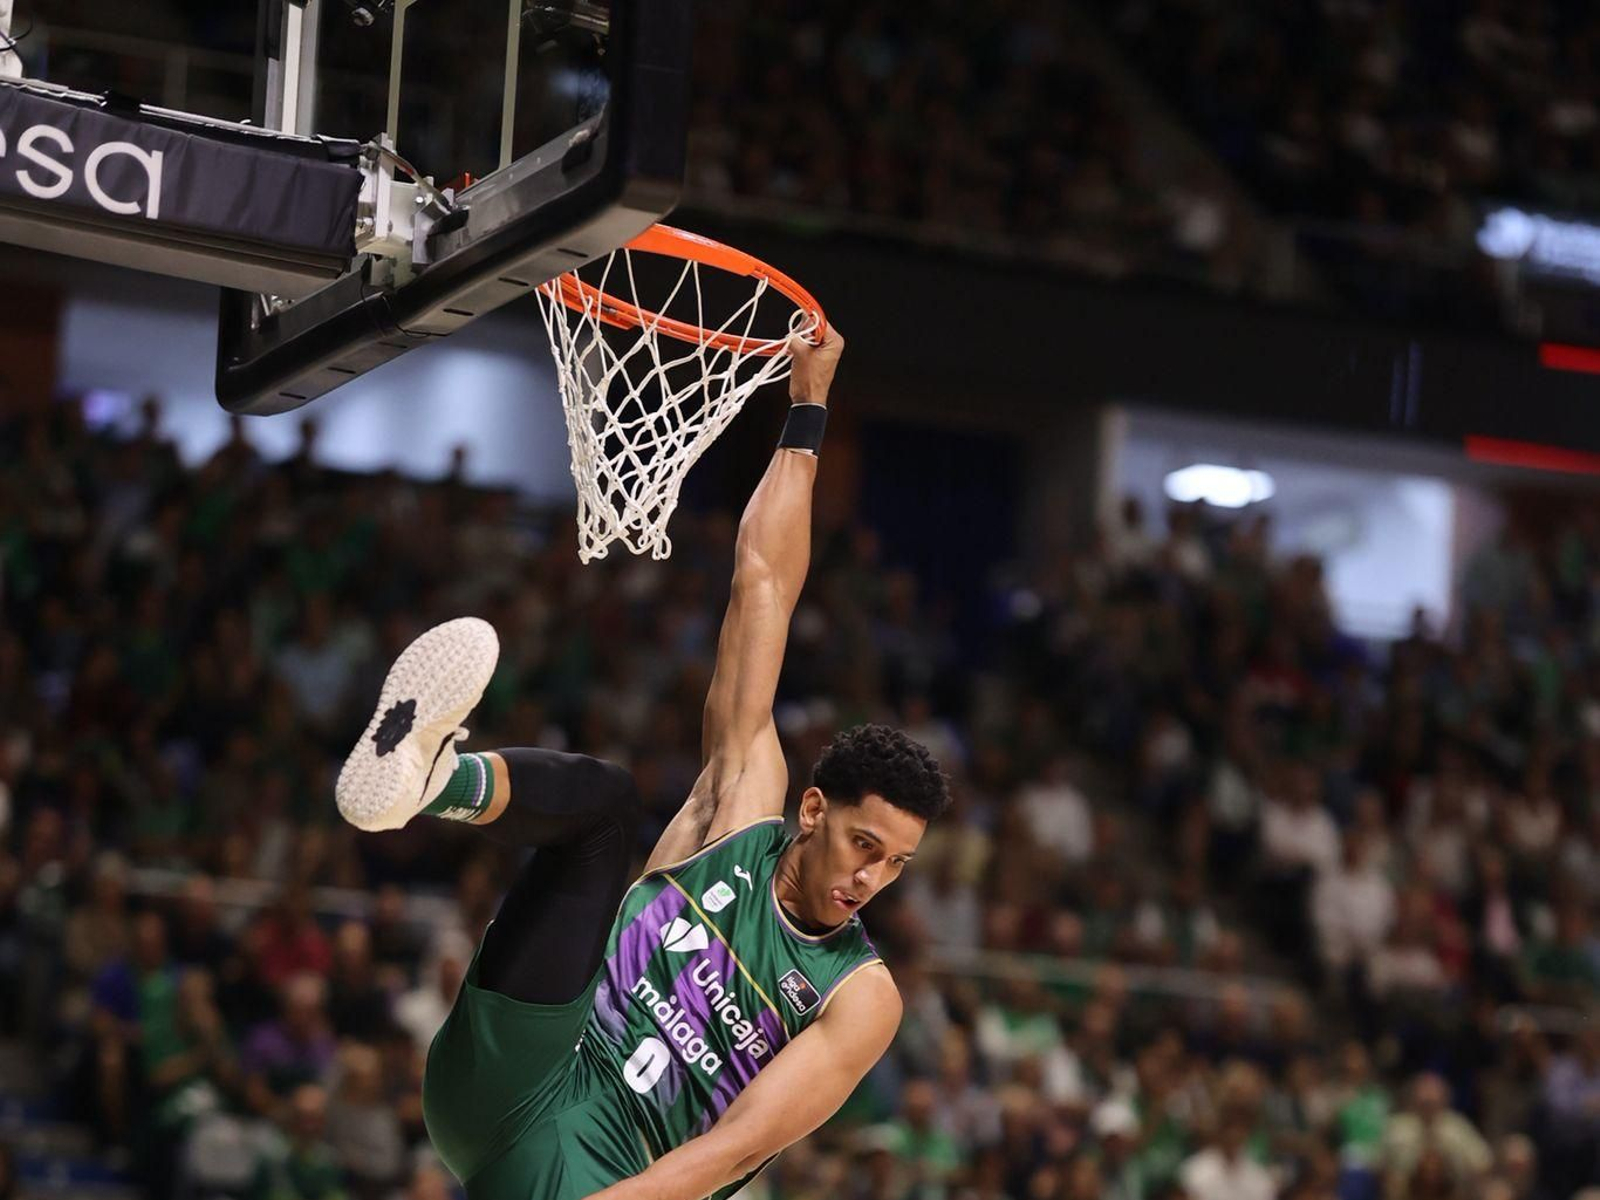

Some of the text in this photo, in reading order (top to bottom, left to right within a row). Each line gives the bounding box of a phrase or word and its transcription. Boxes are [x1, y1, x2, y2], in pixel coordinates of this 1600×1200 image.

[0, 124, 163, 220] sa
[692, 958, 769, 1060] Unicaja
[623, 1037, 671, 1094] 0
